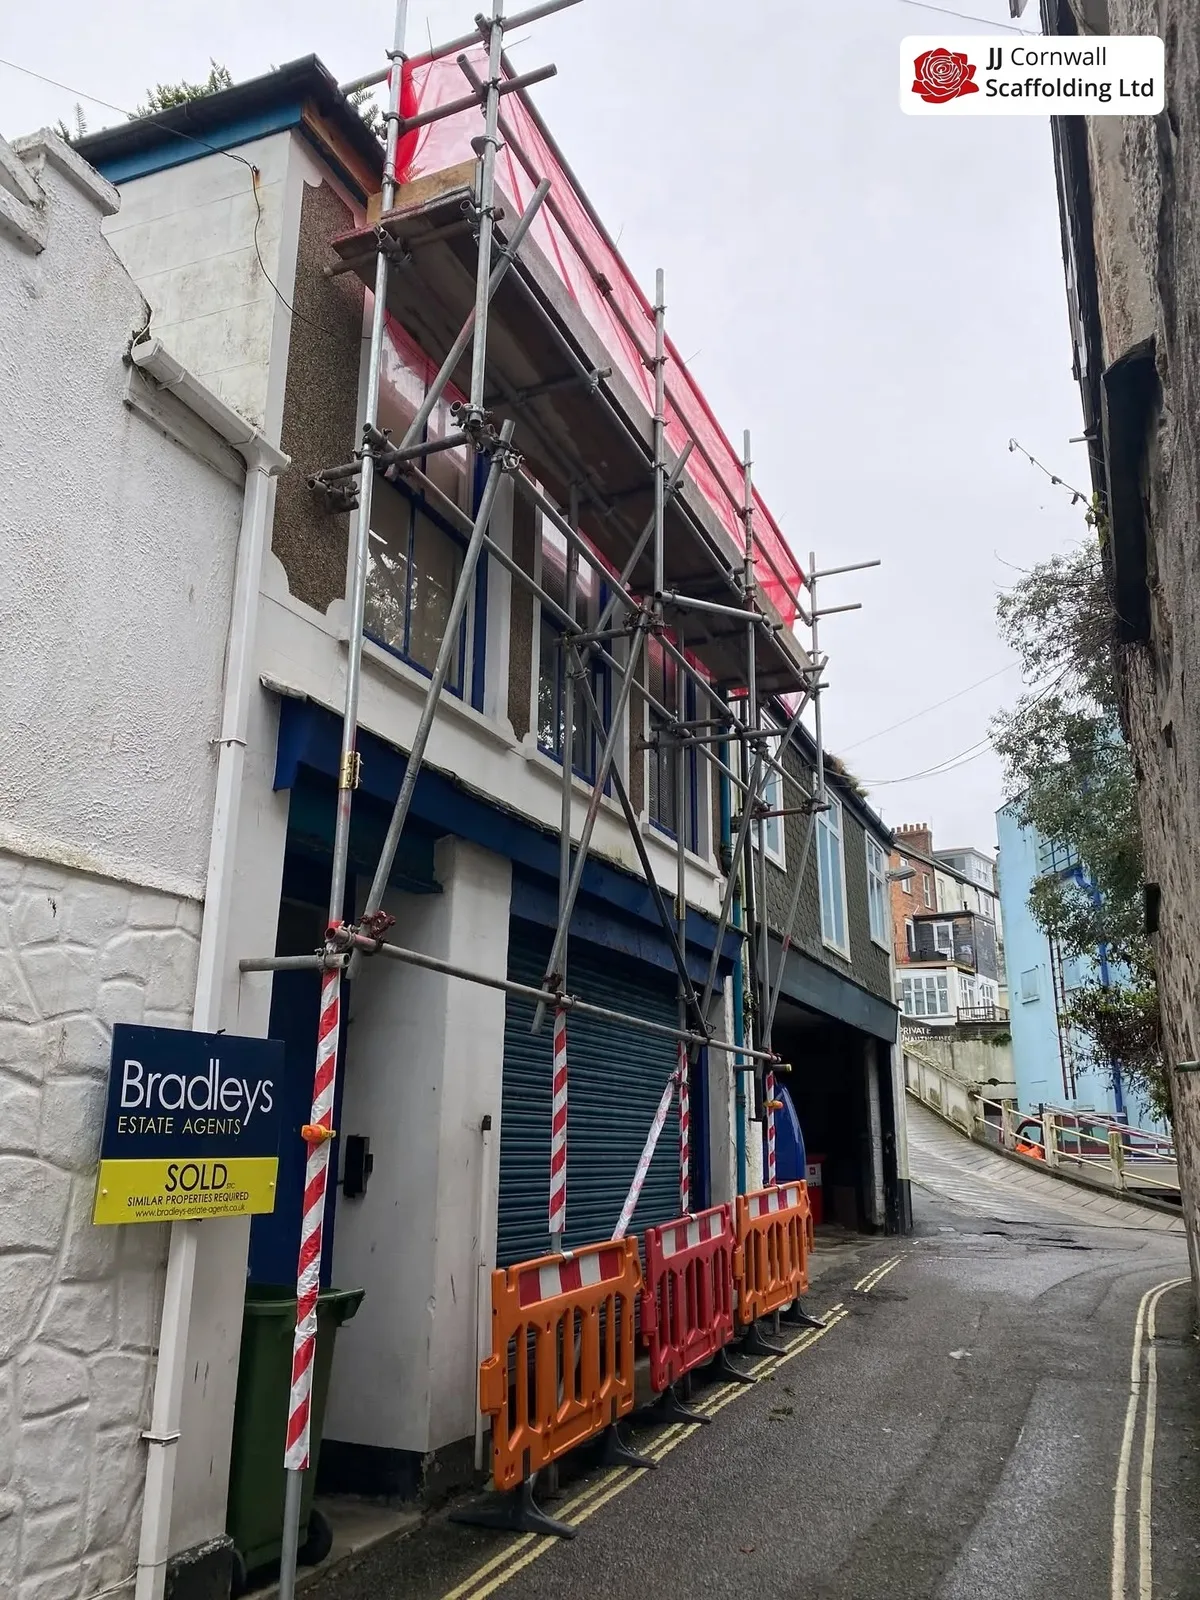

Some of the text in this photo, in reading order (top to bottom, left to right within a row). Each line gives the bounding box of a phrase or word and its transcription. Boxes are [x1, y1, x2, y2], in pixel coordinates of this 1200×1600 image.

[899, 1026, 932, 1035] PRIVATE
[120, 1058, 274, 1126] Bradleys
[117, 1116, 241, 1135] ESTATE AGENTS
[164, 1163, 228, 1192] SOLD
[127, 1191, 249, 1207] SIMILAR PROPERTIES REQUIRED
[135, 1203, 245, 1218] www.bradleys-estate-agents.co.uk
